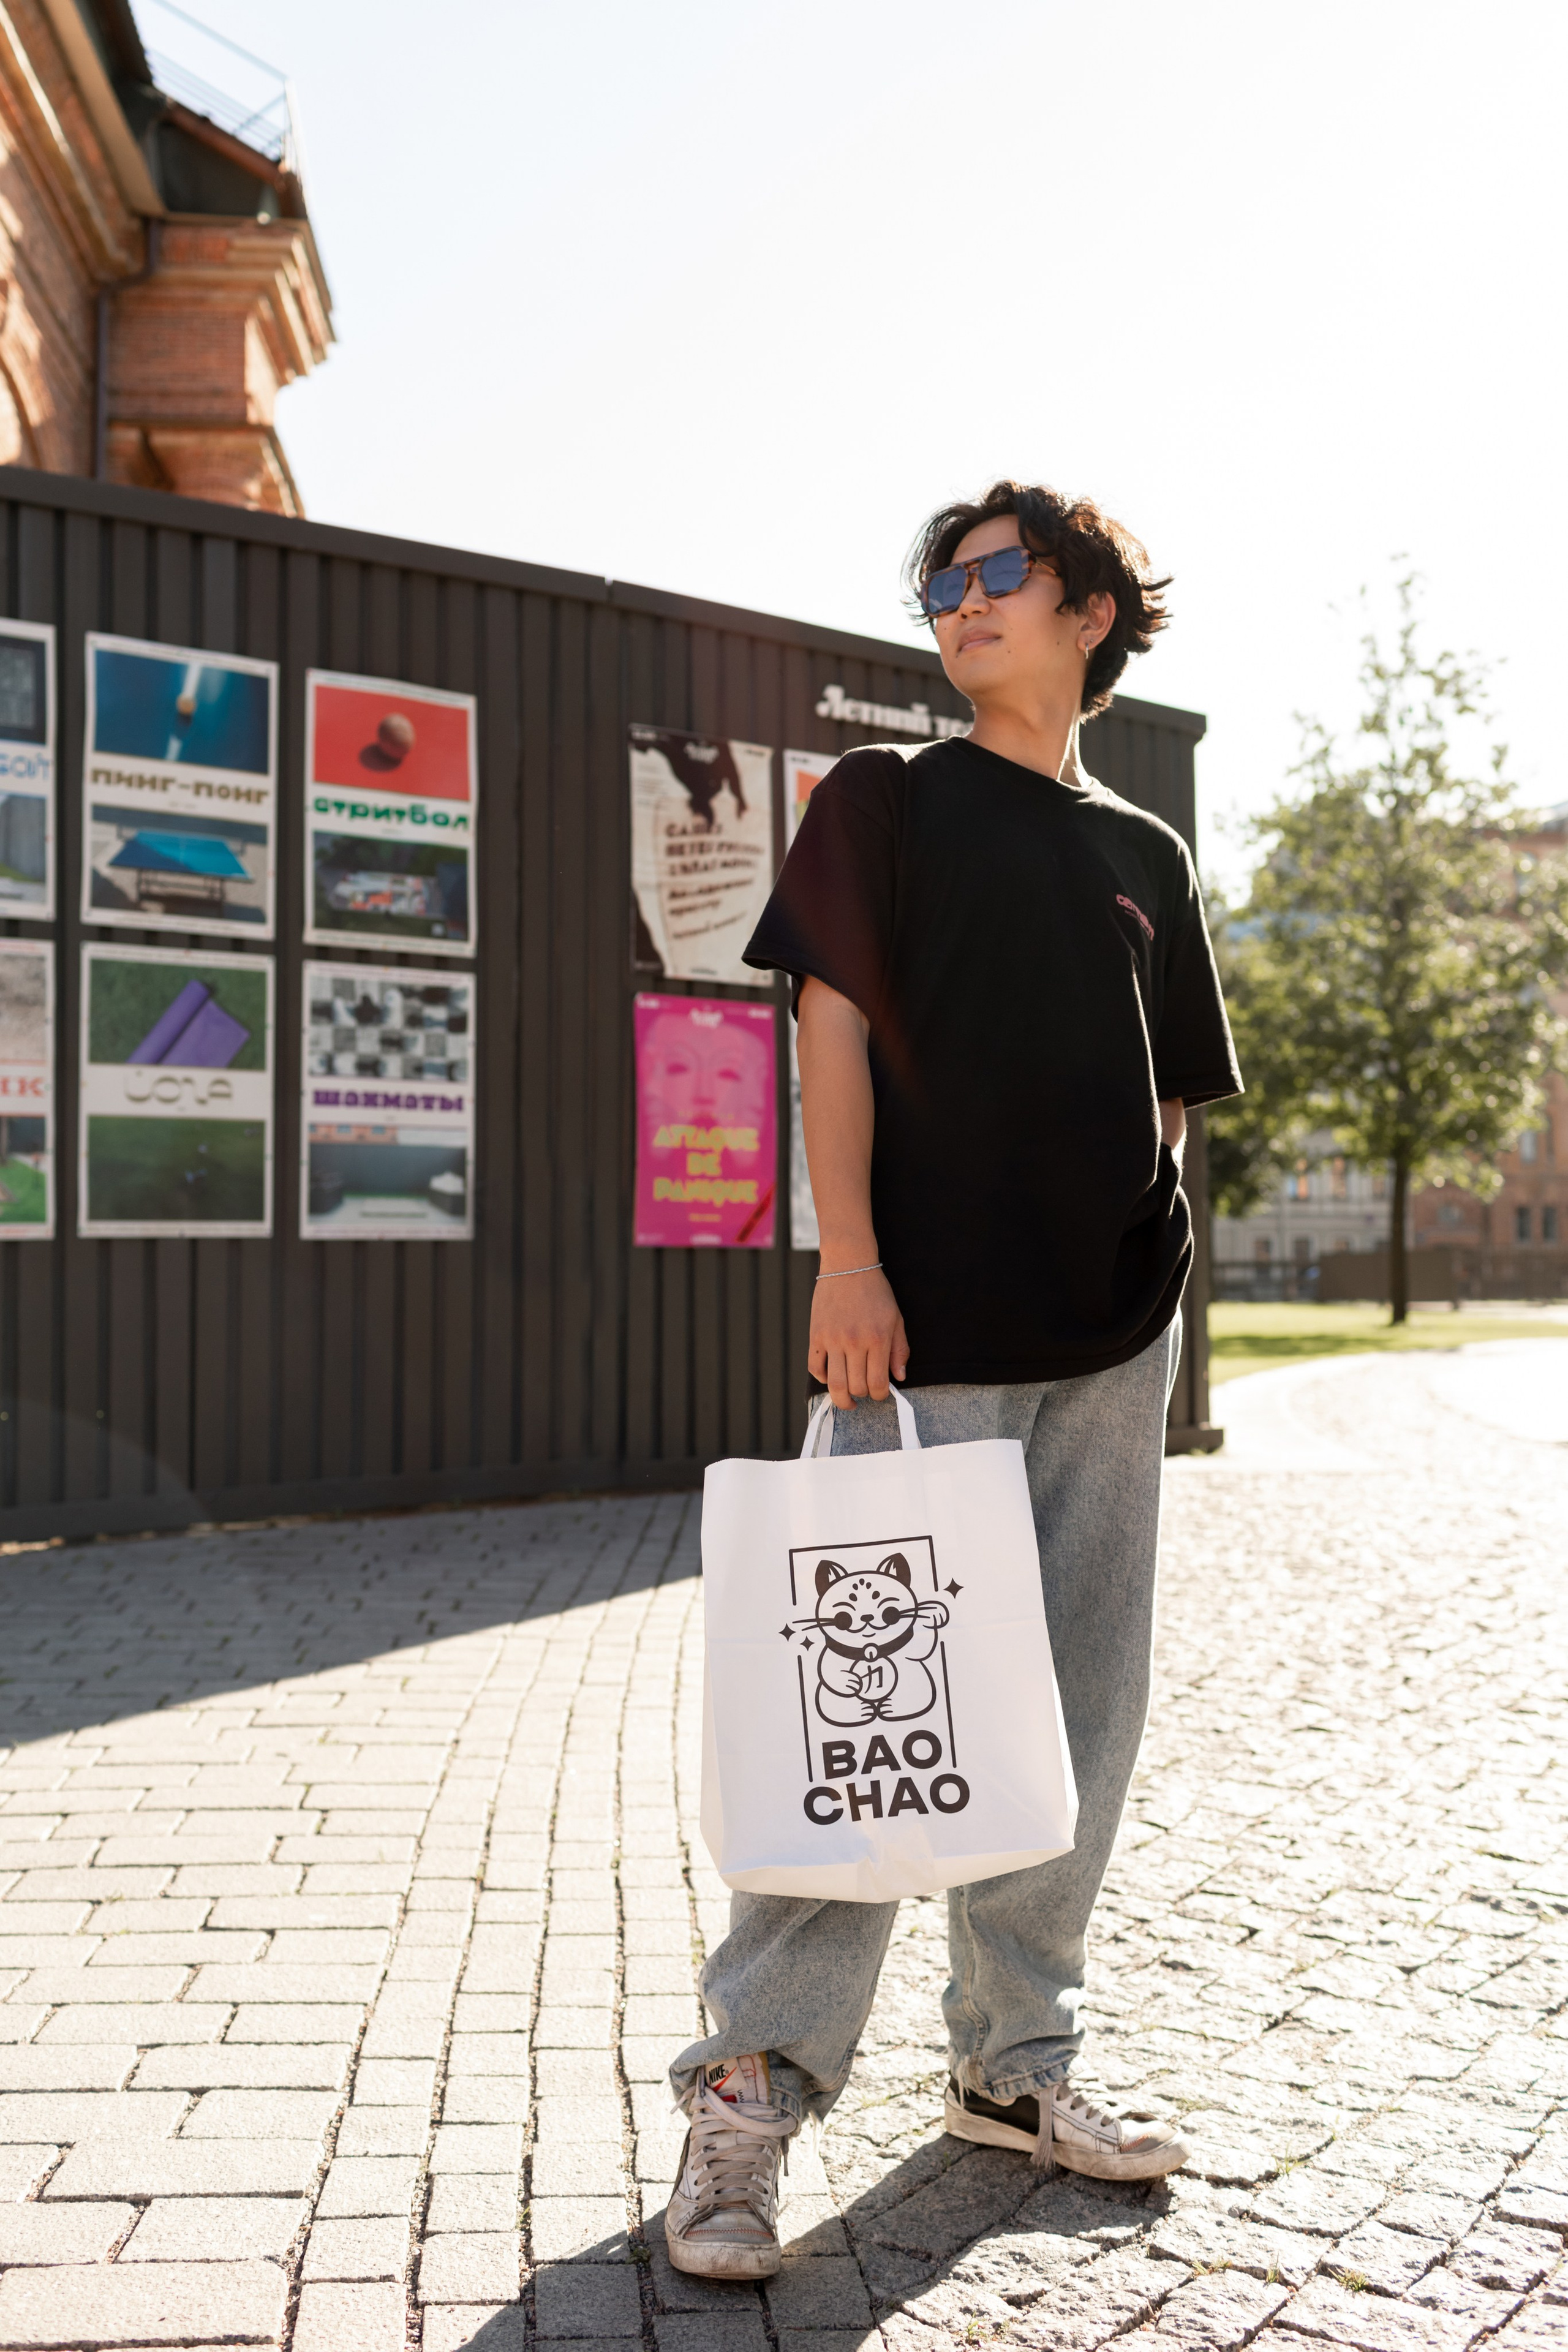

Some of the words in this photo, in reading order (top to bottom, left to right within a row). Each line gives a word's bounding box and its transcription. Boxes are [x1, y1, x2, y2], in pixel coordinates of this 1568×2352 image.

[822, 1730, 942, 1780] BAO
[804, 1773, 970, 1825] CHAO
[709, 2064, 726, 2084] NIKE
